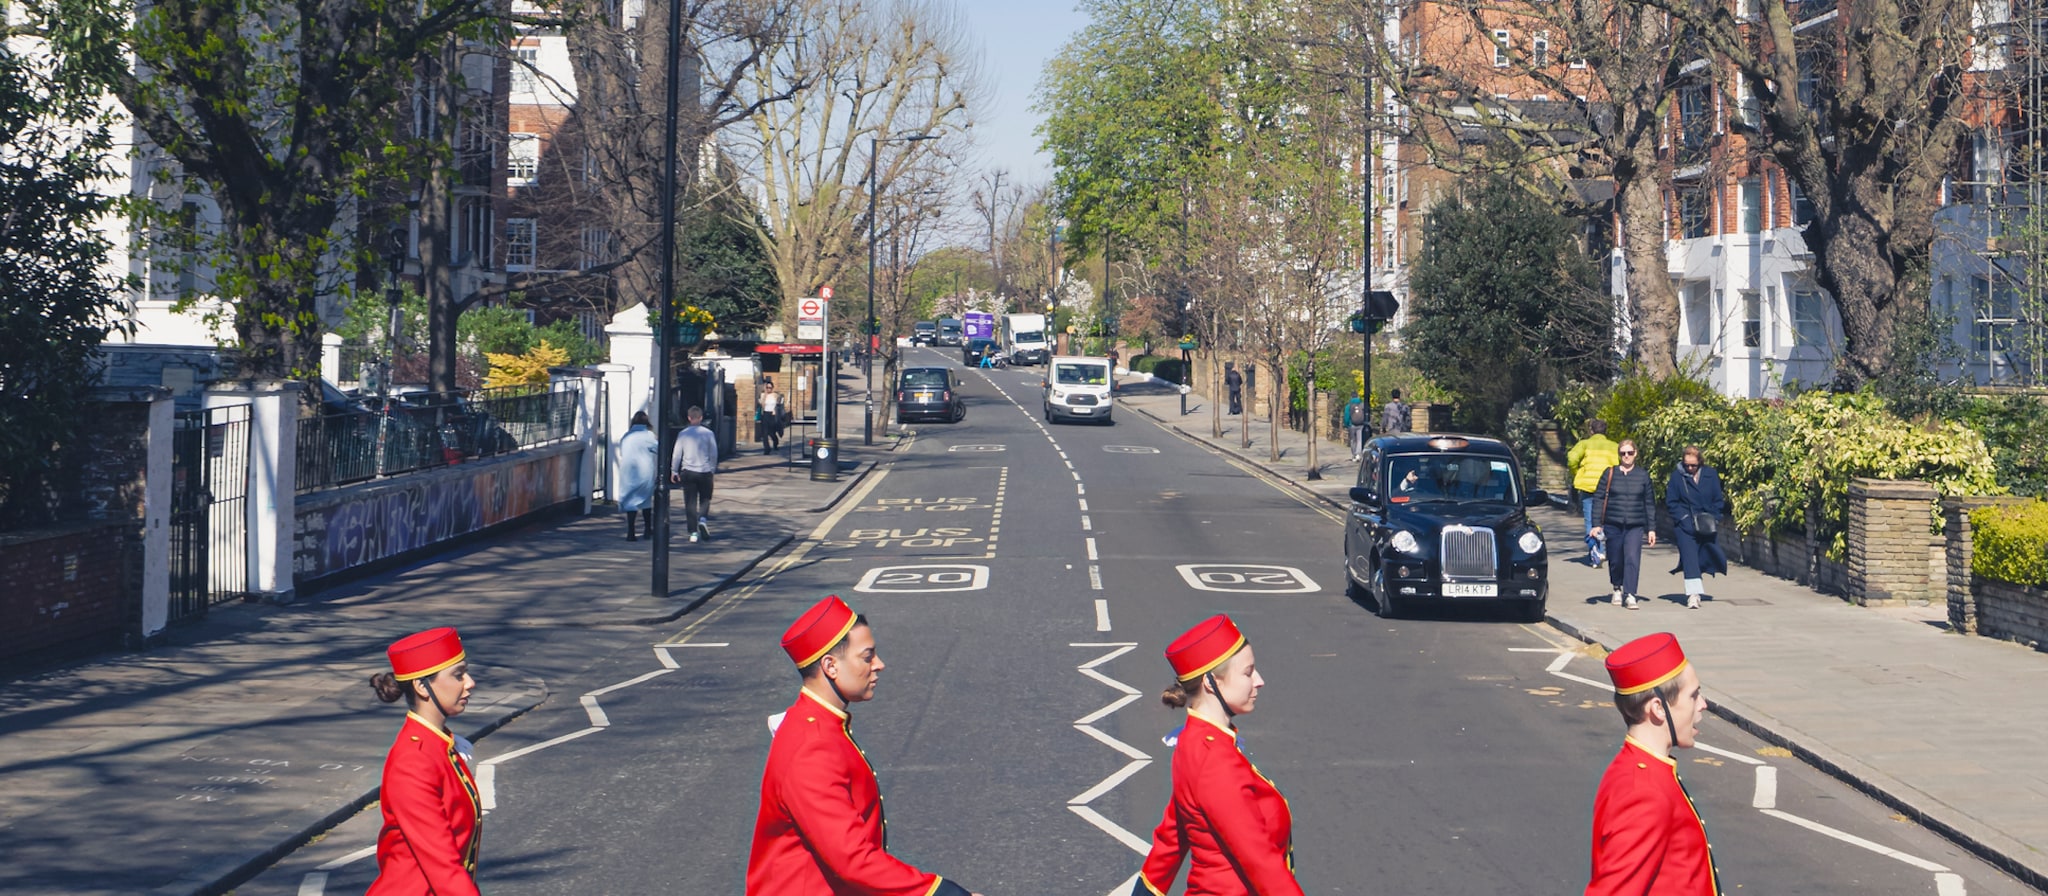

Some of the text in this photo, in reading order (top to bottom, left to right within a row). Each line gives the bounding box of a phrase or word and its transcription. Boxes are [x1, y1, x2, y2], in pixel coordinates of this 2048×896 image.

[822, 287, 832, 298] R
[877, 497, 978, 505] BUS
[855, 504, 993, 512] STOP
[849, 527, 973, 540] BUS
[822, 537, 985, 548] STOP
[875, 572, 972, 584] 20
[1199, 572, 1296, 585] 20
[1448, 585, 1491, 594] LR14 KTP
